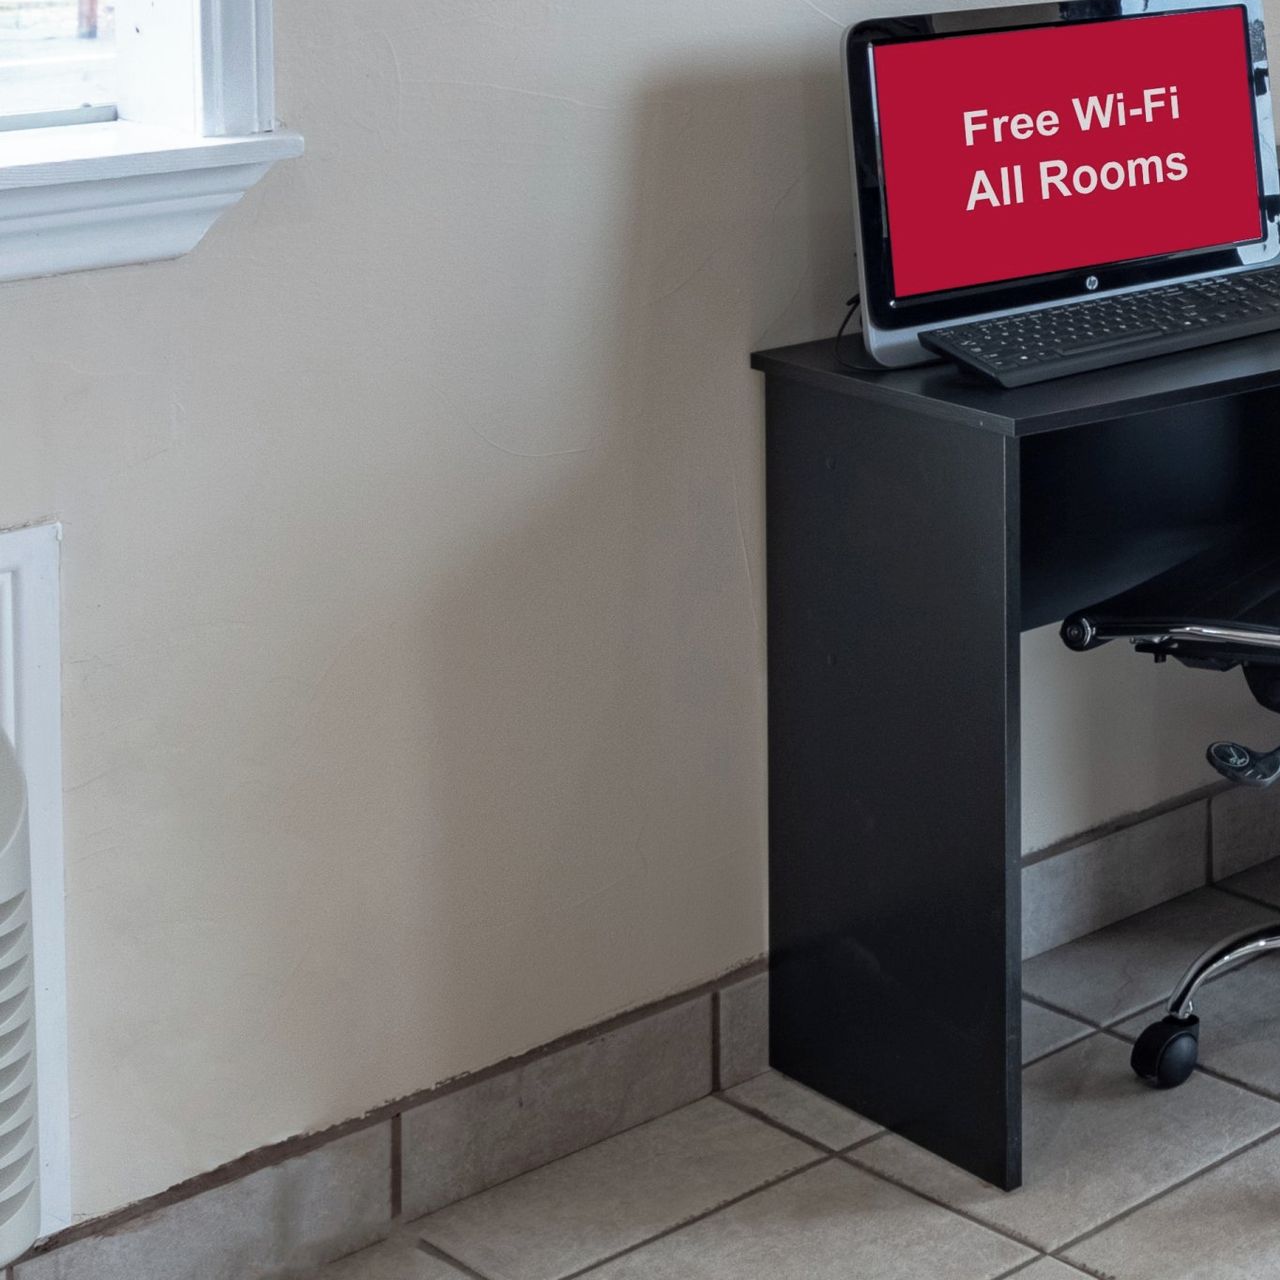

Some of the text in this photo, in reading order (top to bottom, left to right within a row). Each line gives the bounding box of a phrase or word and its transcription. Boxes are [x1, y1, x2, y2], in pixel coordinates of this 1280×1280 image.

[963, 85, 1180, 147] Free Wi-Fi
[965, 151, 1189, 211] All Rooms
